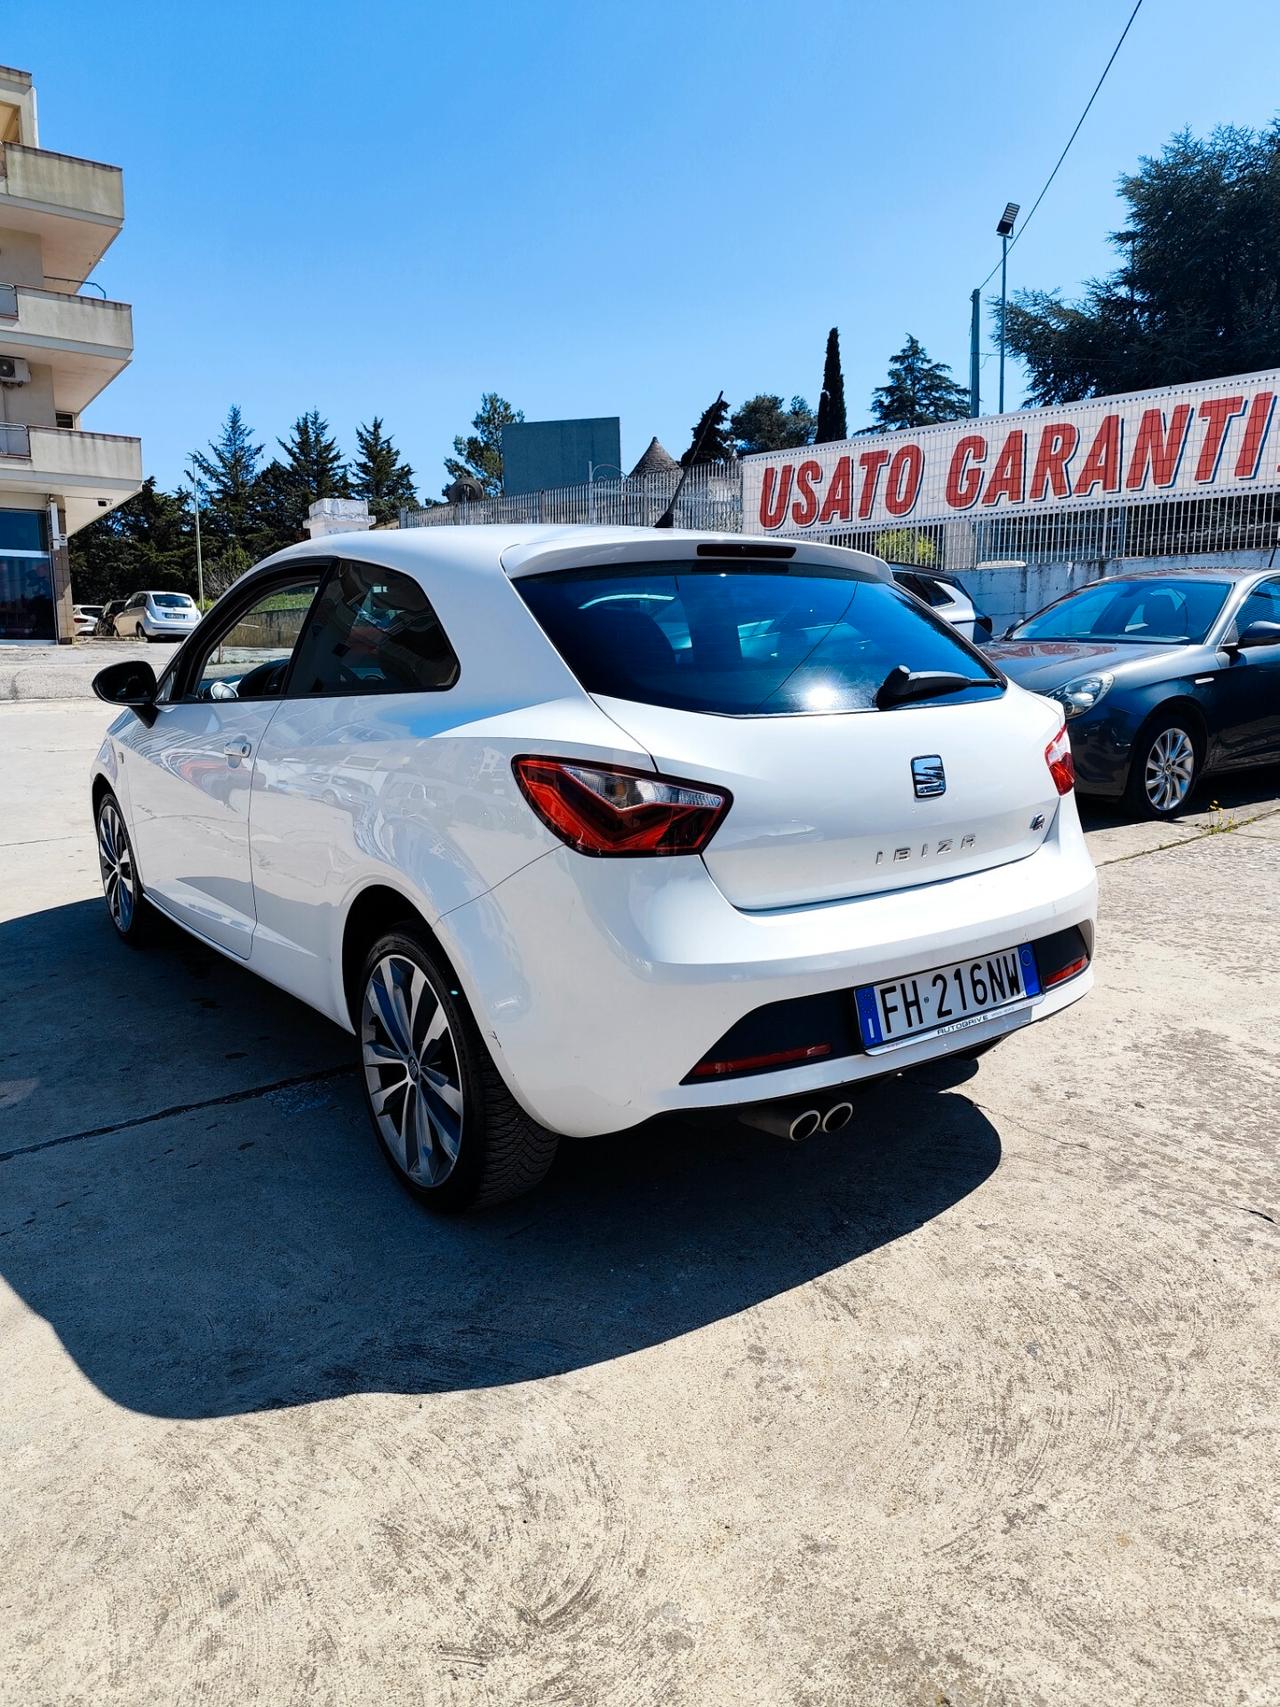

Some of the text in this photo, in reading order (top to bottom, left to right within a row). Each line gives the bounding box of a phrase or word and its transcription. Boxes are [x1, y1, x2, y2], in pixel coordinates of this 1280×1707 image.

[759, 391, 1280, 531] USATO GARANTI
[875, 833, 977, 866] IBIZA
